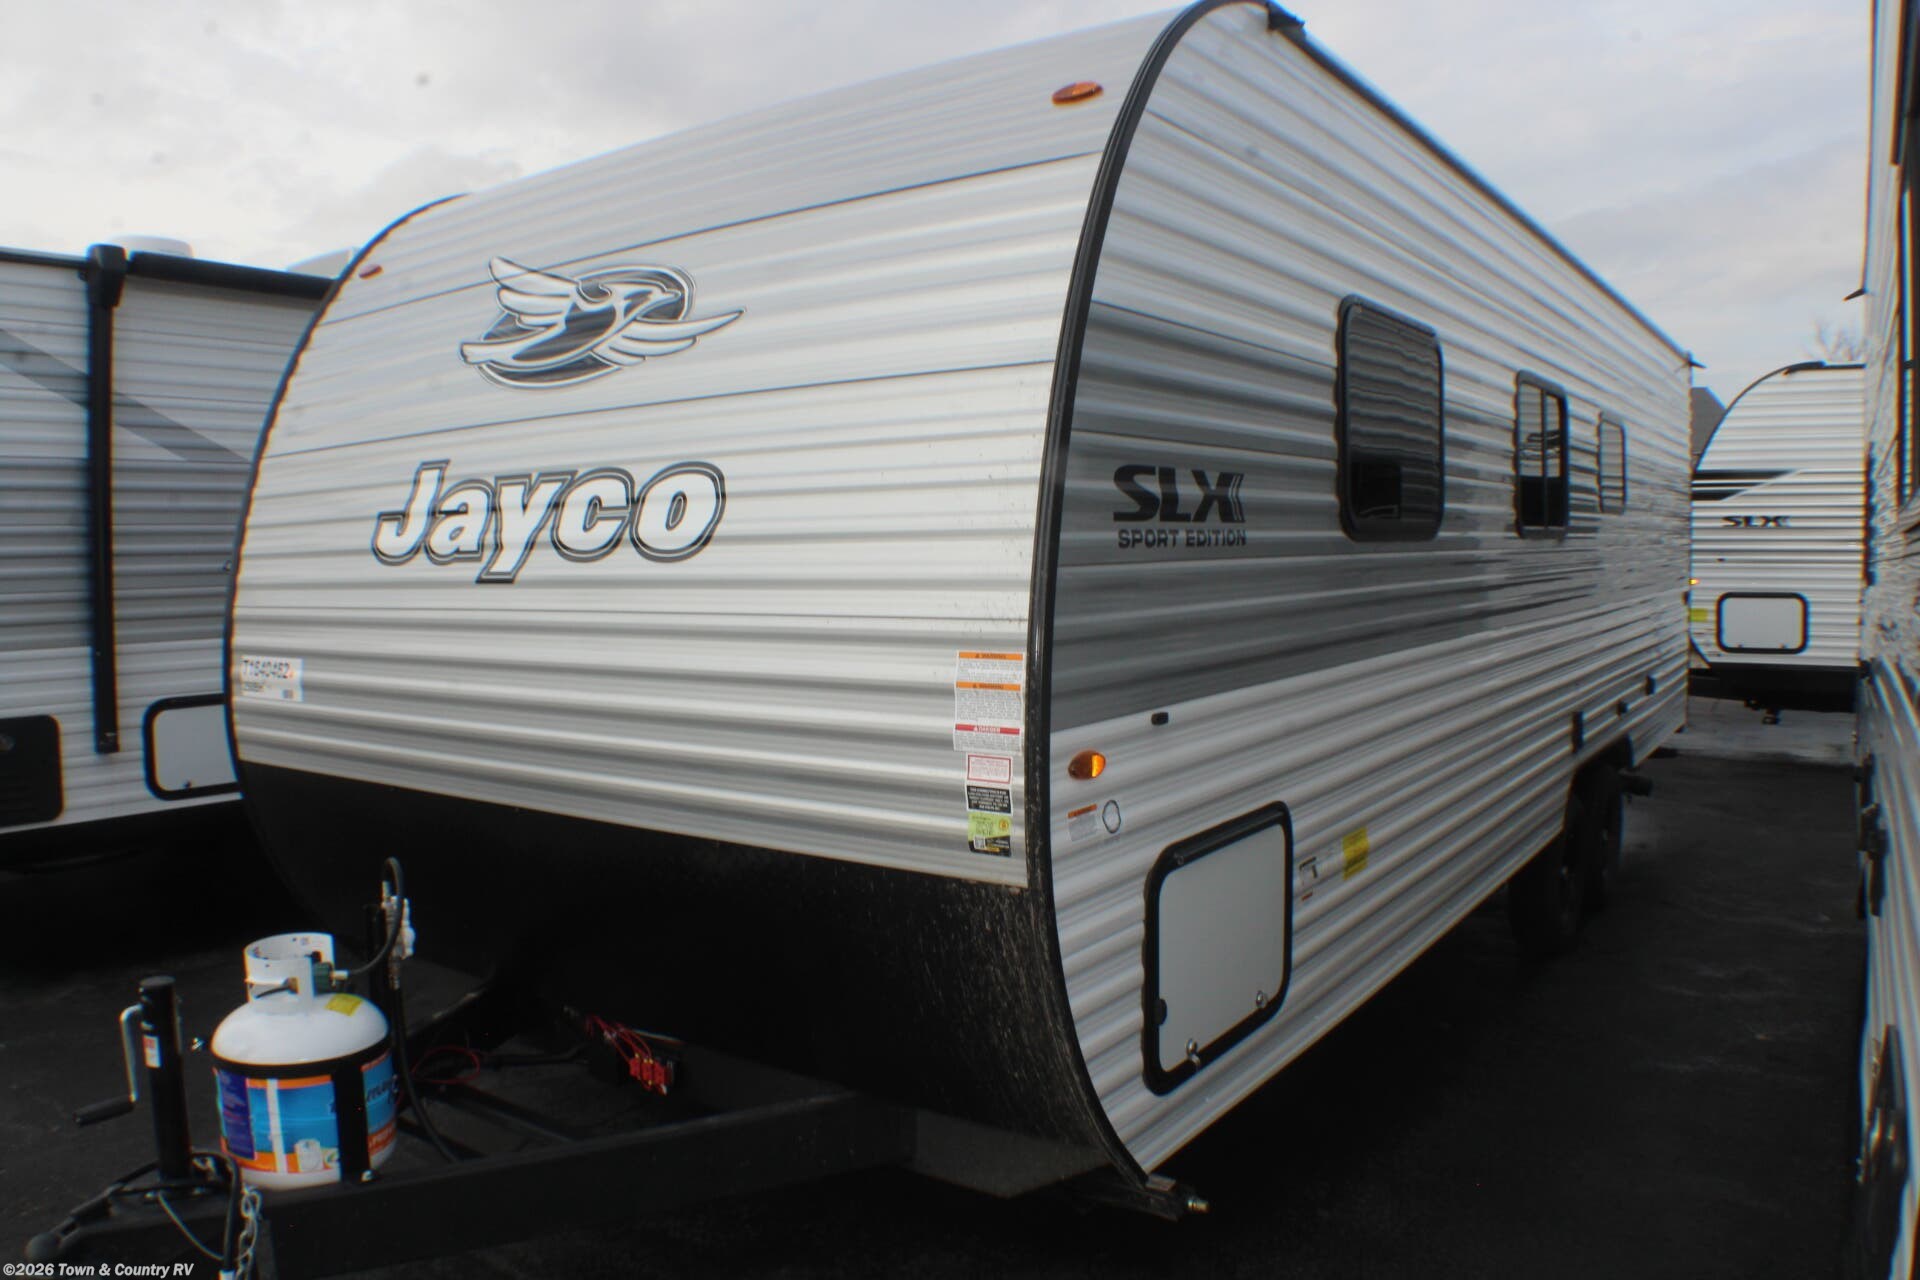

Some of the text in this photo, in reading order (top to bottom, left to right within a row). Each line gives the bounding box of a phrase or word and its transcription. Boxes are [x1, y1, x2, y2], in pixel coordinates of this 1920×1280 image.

[1113, 464, 1246, 523] SLX
[370, 459, 727, 585] Jayco
[1117, 529, 1248, 549] SPORT EDITION
[1721, 515, 1792, 529] SLX
